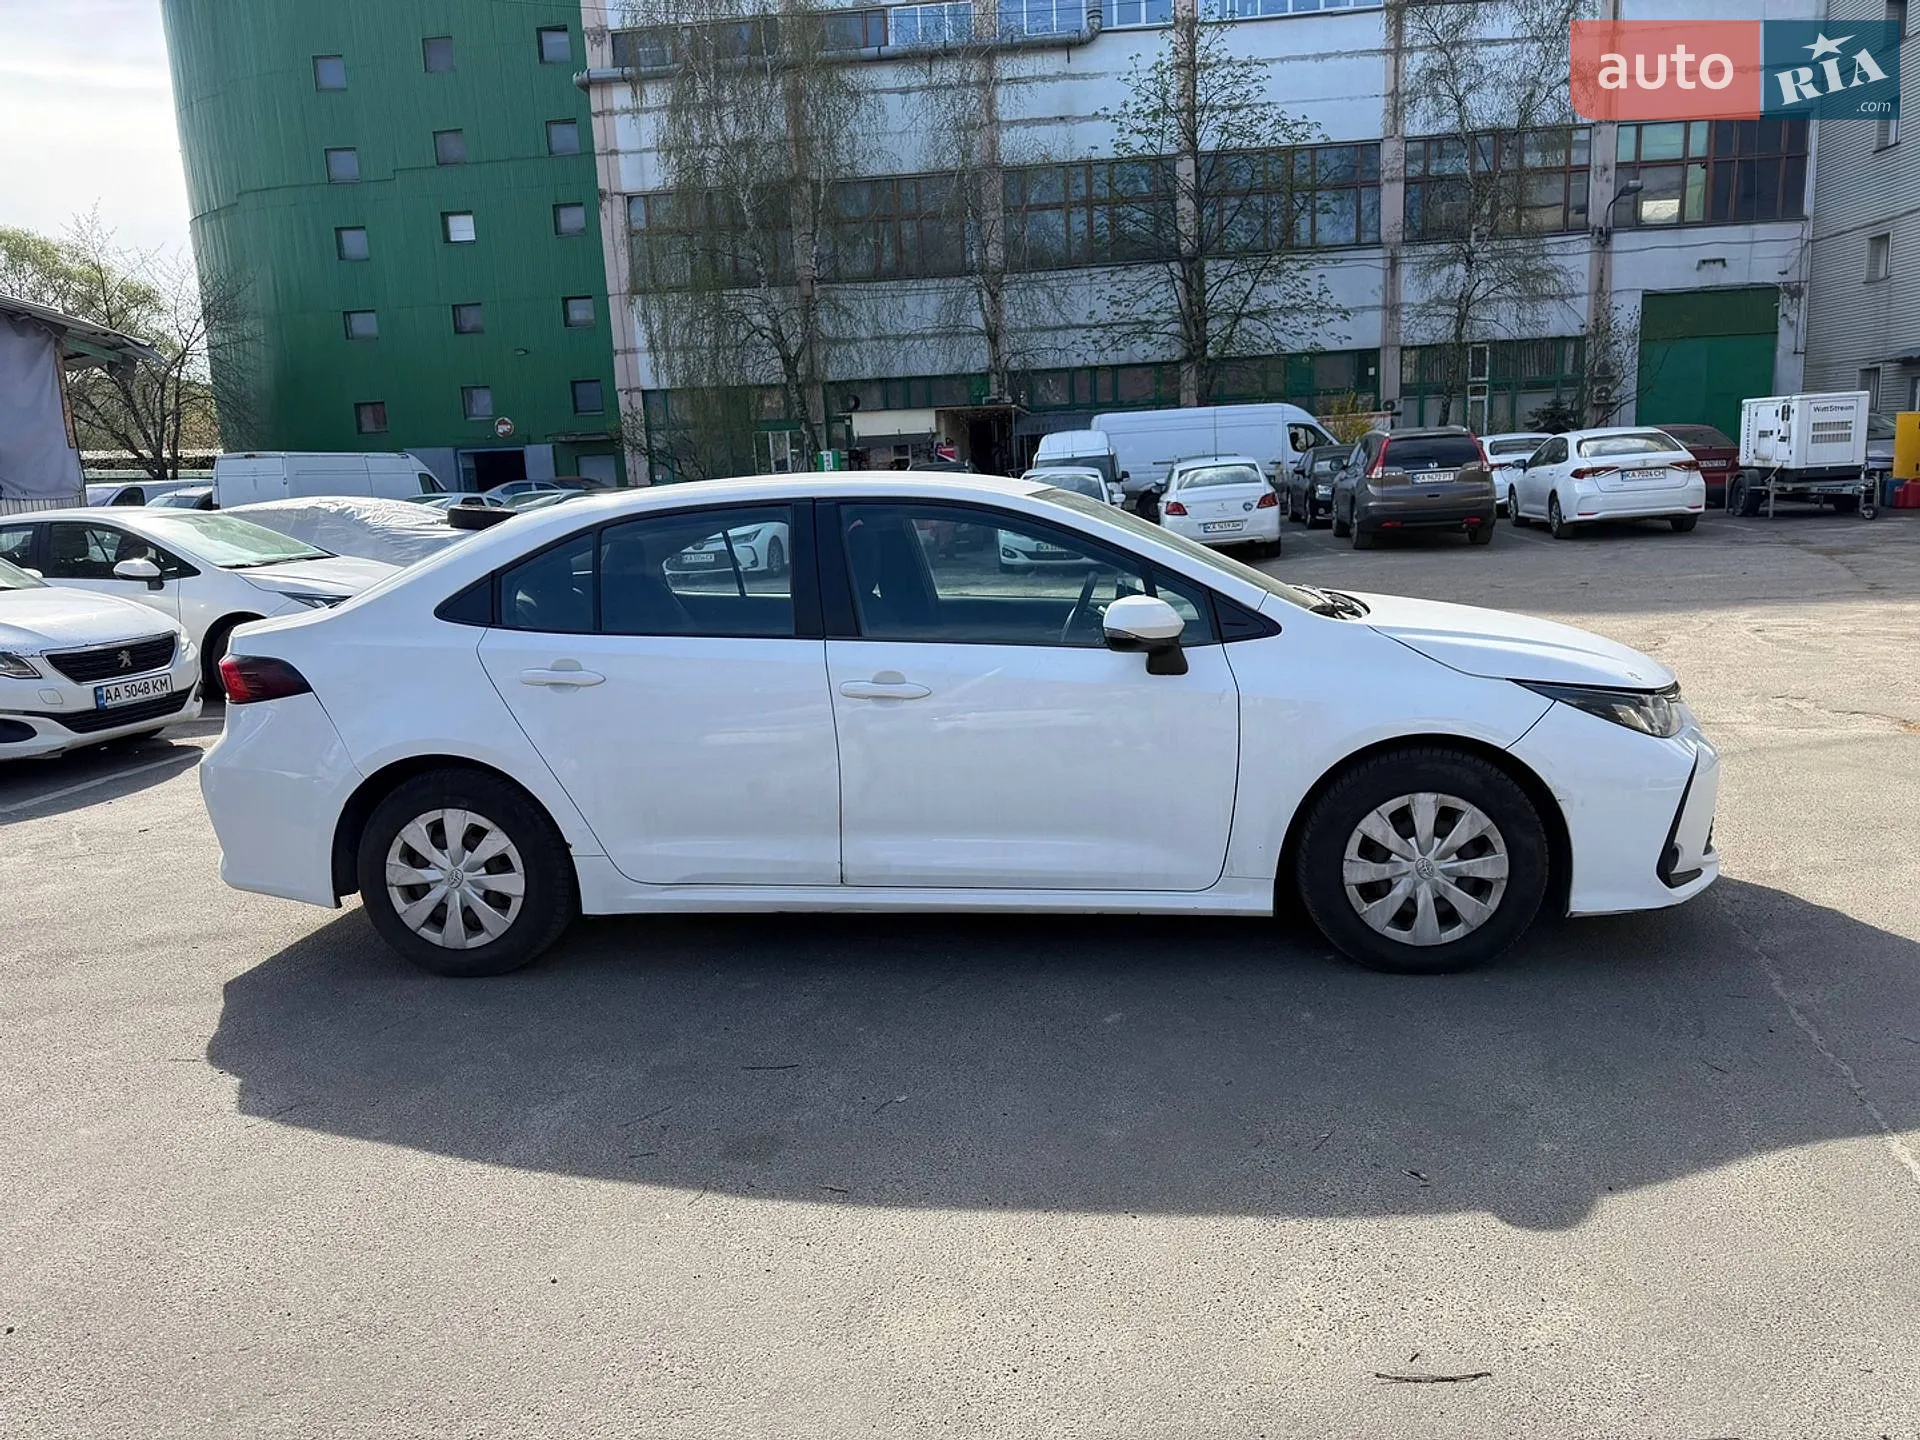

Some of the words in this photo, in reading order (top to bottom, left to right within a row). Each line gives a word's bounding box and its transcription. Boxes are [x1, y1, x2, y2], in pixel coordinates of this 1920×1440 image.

[105, 687, 122, 703] AA
[124, 681, 151, 698] 5048
[151, 678, 169, 694] KM
